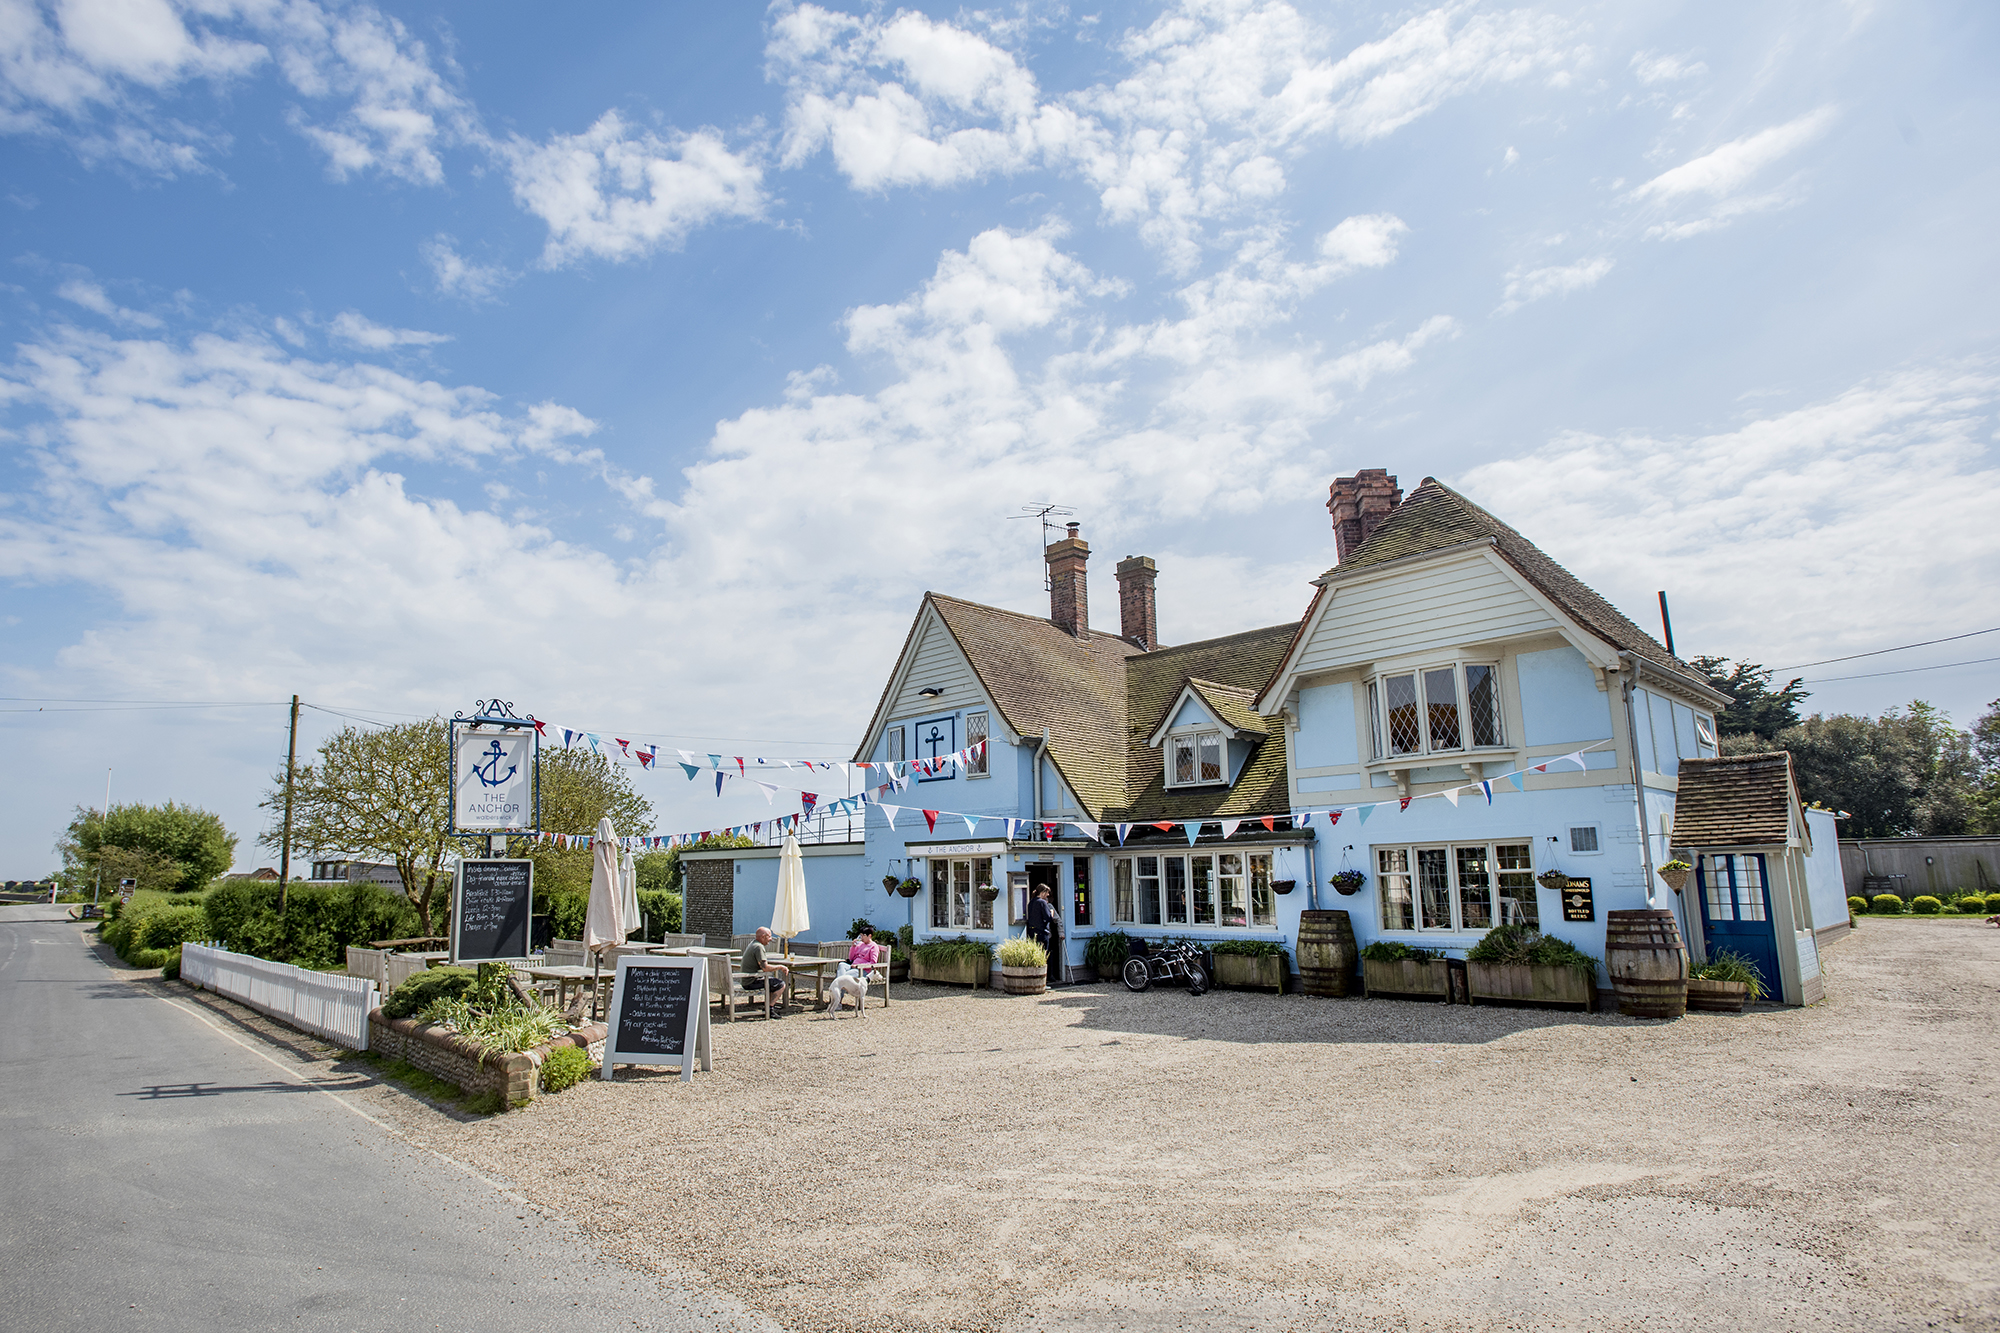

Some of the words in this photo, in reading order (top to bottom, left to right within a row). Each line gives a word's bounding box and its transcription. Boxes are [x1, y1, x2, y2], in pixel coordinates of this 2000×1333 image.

[485, 699, 507, 717] A
[483, 793, 506, 802] THE
[468, 803, 520, 813] ANCHOR
[948, 845, 975, 853] ANCHOR
